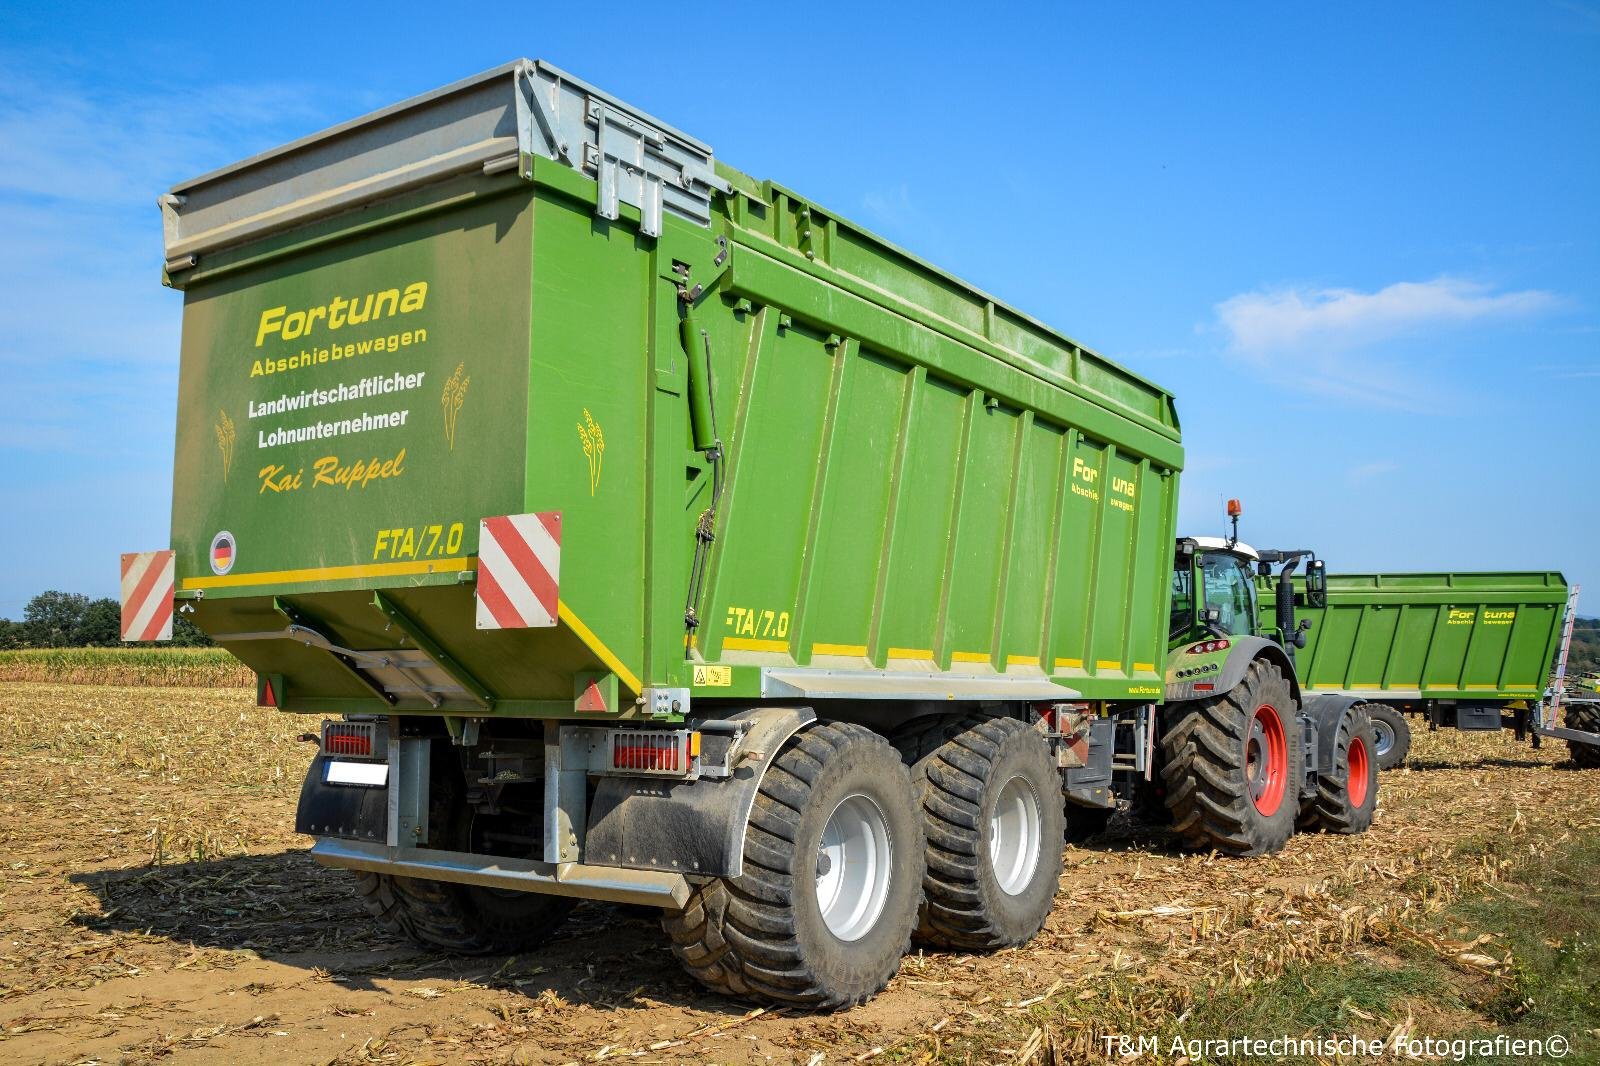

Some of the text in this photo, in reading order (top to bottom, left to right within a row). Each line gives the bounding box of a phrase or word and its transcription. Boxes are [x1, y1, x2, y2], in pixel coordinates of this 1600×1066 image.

[255, 281, 428, 347] Fortuna
[250, 328, 427, 377] Abschiebewagen
[248, 370, 425, 418] Landwirtschaftlicher
[258, 409, 409, 449] Lohnunternehmer
[259, 448, 406, 494] Kai Ruppel
[374, 522, 464, 561] FTA/7.0
